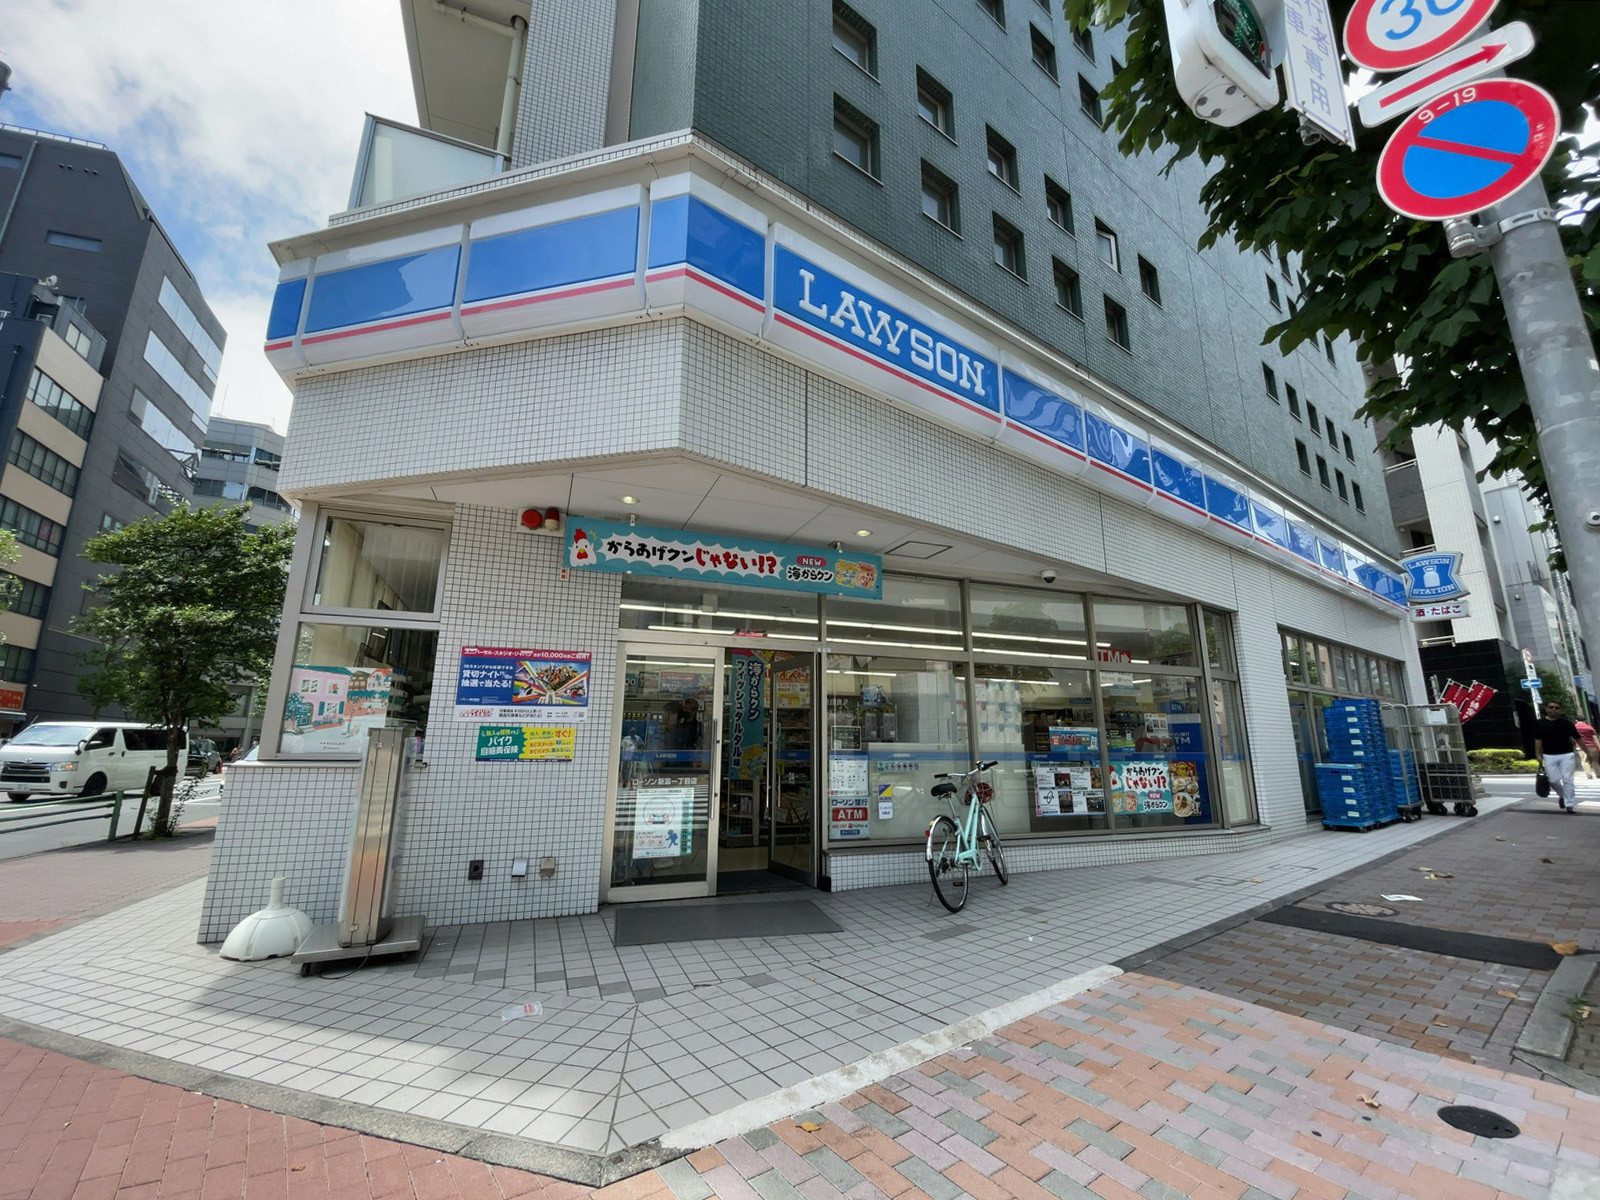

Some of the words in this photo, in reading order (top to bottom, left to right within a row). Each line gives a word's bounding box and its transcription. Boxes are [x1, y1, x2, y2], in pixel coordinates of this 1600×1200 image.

[1418, 87, 1476, 124] 9-19
[799, 268, 986, 397] LAWSON
[802, 558, 822, 566] NEW
[1409, 558, 1450, 569] LAWSON
[788, 566, 833, 581] 海からクン
[1413, 584, 1456, 595] STATION
[747, 660, 764, 721] 海からクン
[488, 736, 513, 747] バイク
[837, 809, 863, 820] ATM
